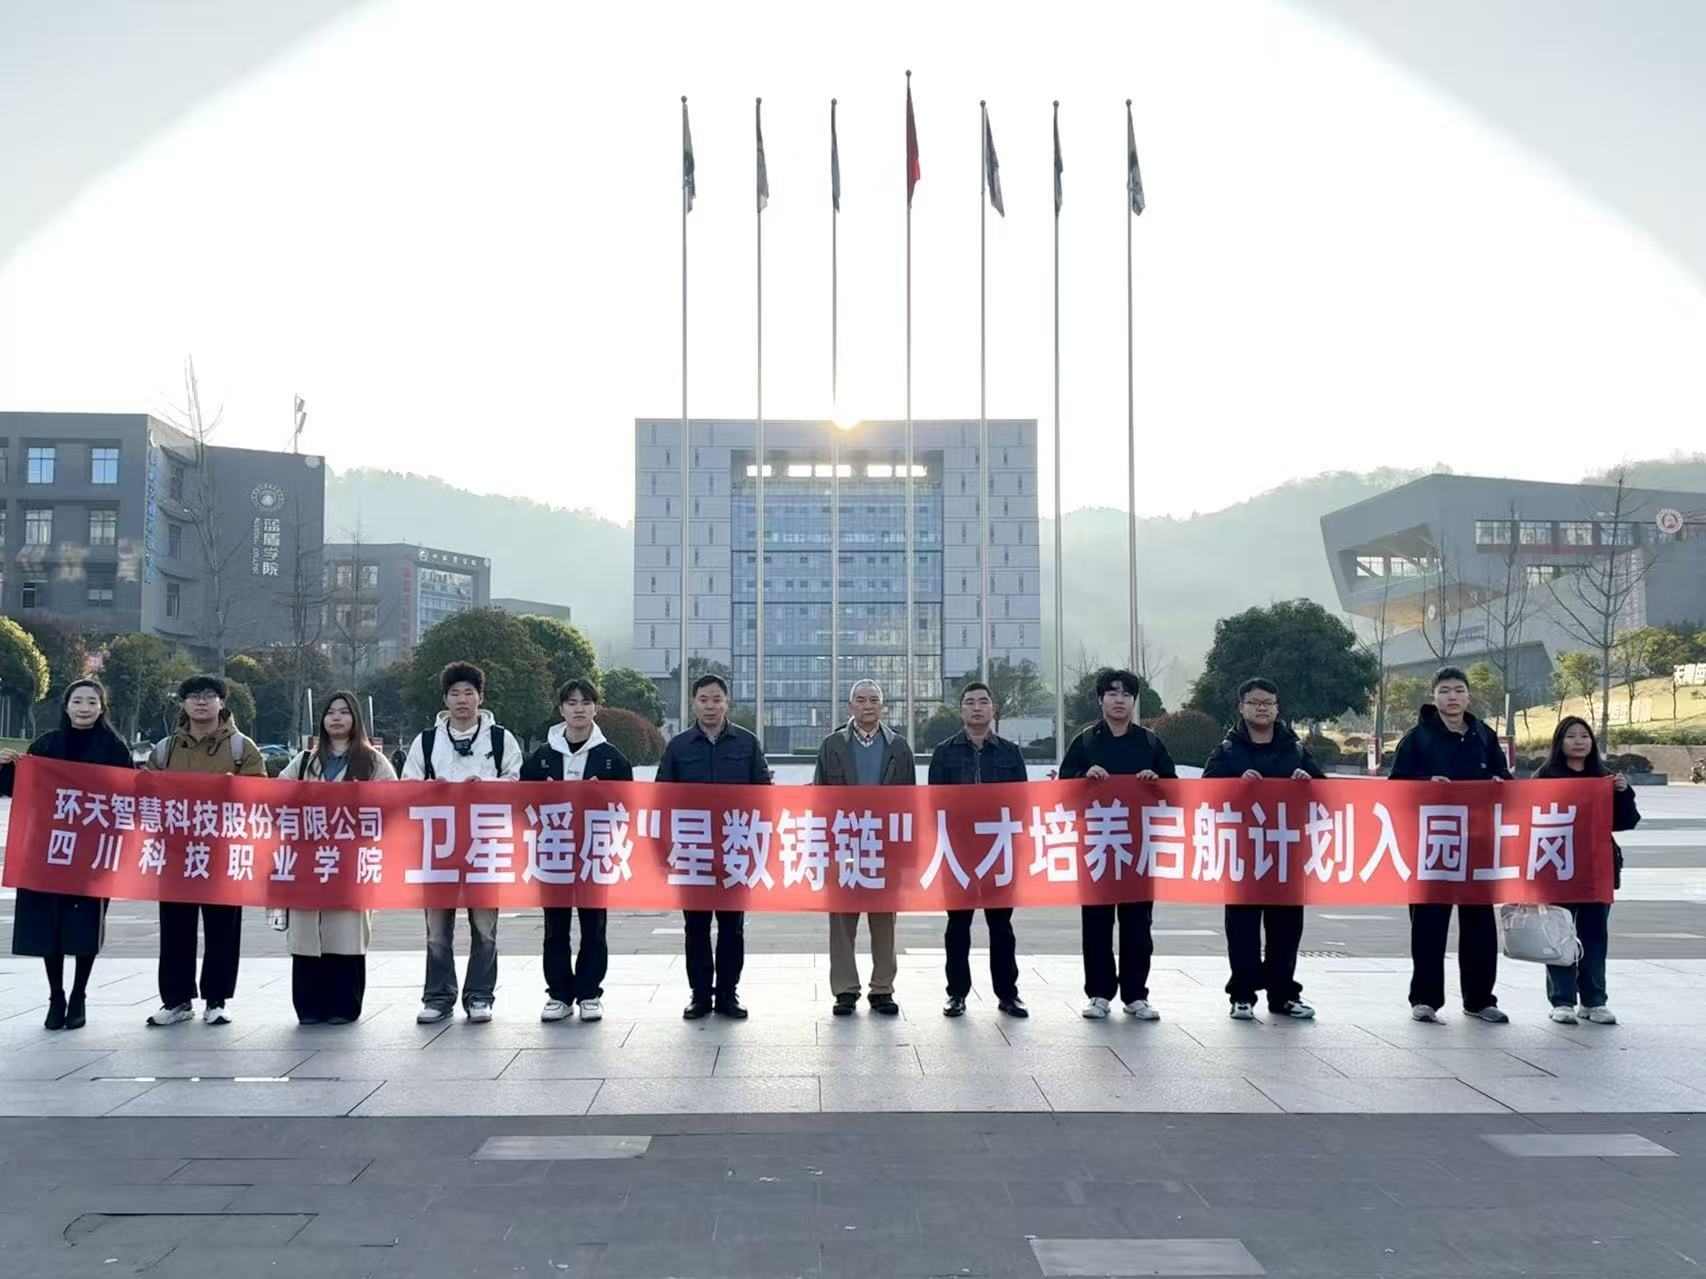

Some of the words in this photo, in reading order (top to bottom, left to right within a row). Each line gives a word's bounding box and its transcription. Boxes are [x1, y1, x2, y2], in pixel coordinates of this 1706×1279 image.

[53, 788, 383, 842] 环天智慧科技股份有限公司
[47, 830, 383, 884] 四川科技职业学院
